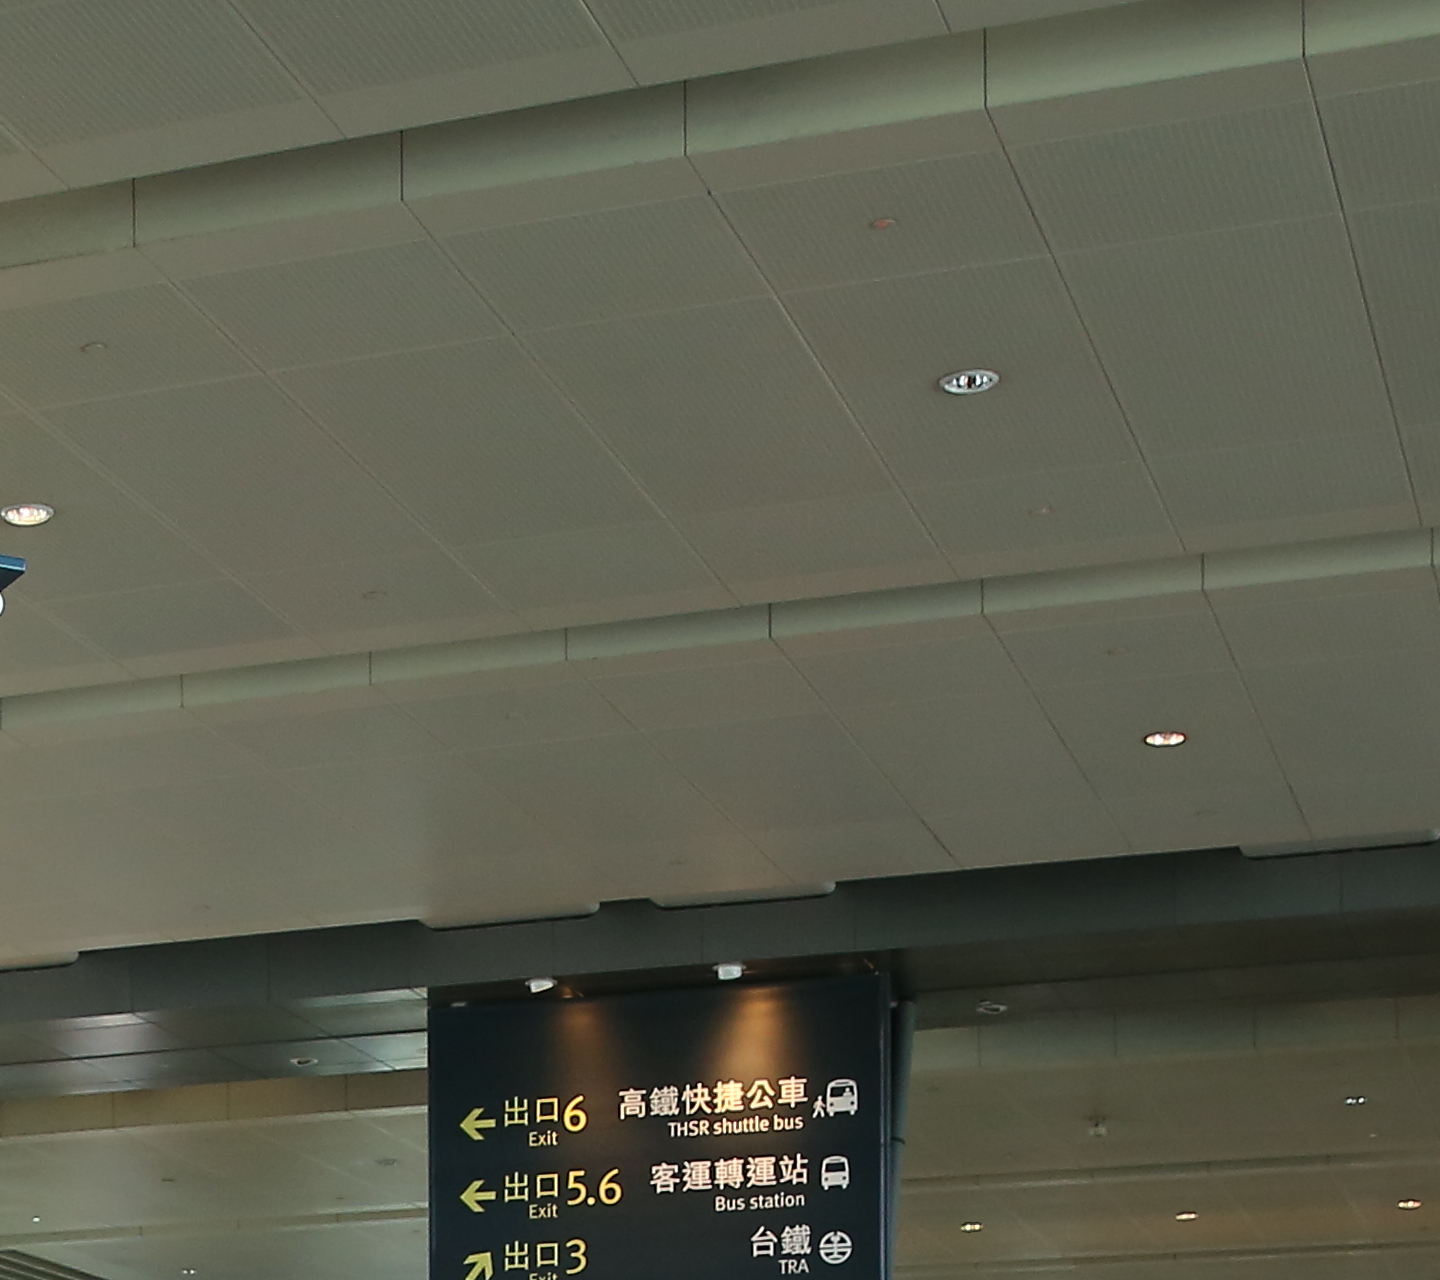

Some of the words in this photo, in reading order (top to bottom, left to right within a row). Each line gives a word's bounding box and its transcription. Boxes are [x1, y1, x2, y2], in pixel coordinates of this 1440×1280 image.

[618, 1075, 809, 1121] 高鐵快捷公車
[667, 1119, 710, 1138] THSR
[712, 1115, 770, 1136] shuttle
[772, 1114, 805, 1132] bus
[528, 1131, 558, 1148] Exit
[649, 1153, 810, 1196] 客運轉運站
[528, 1203, 558, 1220] Exit
[714, 1195, 747, 1213] Bus
[749, 1191, 806, 1211] station
[749, 1224, 812, 1259] 台鐵
[778, 1258, 810, 1276] TRA
